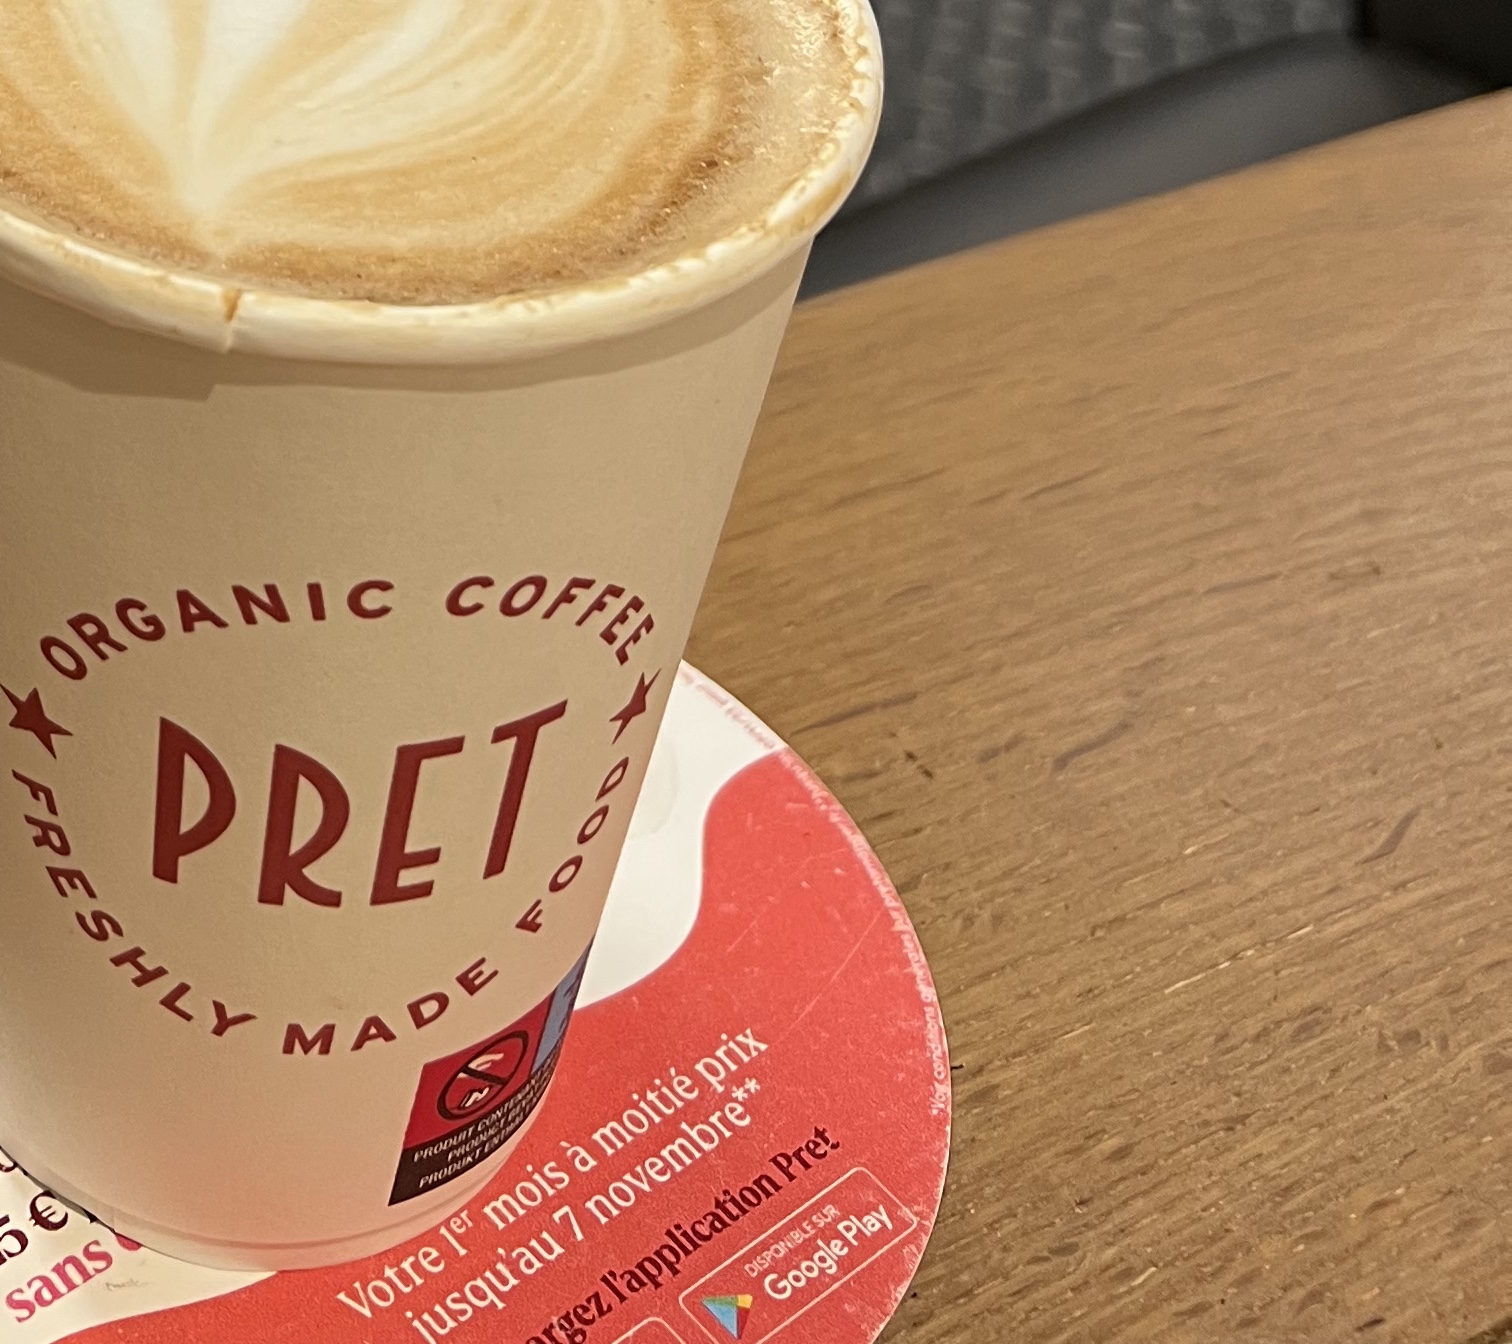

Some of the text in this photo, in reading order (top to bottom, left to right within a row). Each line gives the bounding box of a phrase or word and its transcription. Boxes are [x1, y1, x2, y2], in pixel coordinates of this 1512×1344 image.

[39, 574, 655, 681] ORGANIC COFFEE
[152, 698, 569, 909] PRET
[11, 768, 258, 1037] FRESHLY
[282, 956, 500, 1056] MADE
[514, 756, 630, 934] FOOD
[336, 1246, 445, 1318] Votre
[439, 1209, 474, 1257] 1er
[483, 1160, 570, 1231] mois
[559, 1140, 598, 1173] à
[591, 1066, 699, 1157] moitié
[694, 1027, 769, 1094] prix
[413, 1125, 476, 1163] PRODUIT
[418, 1147, 481, 1189] PRODUKT
[446, 1115, 506, 1163] PRODUCT
[28, 1190, 69, 1232] €
[525, 1125, 840, 1344] rgez l'application Pret
[744, 1203, 841, 1278] DISPONIBLE SUR
[763, 1204, 893, 1300] Google Play
[4, 1239, 114, 1324] sans
[405, 1230, 565, 1344] jusqu'au
[552, 1204, 585, 1242] 7
